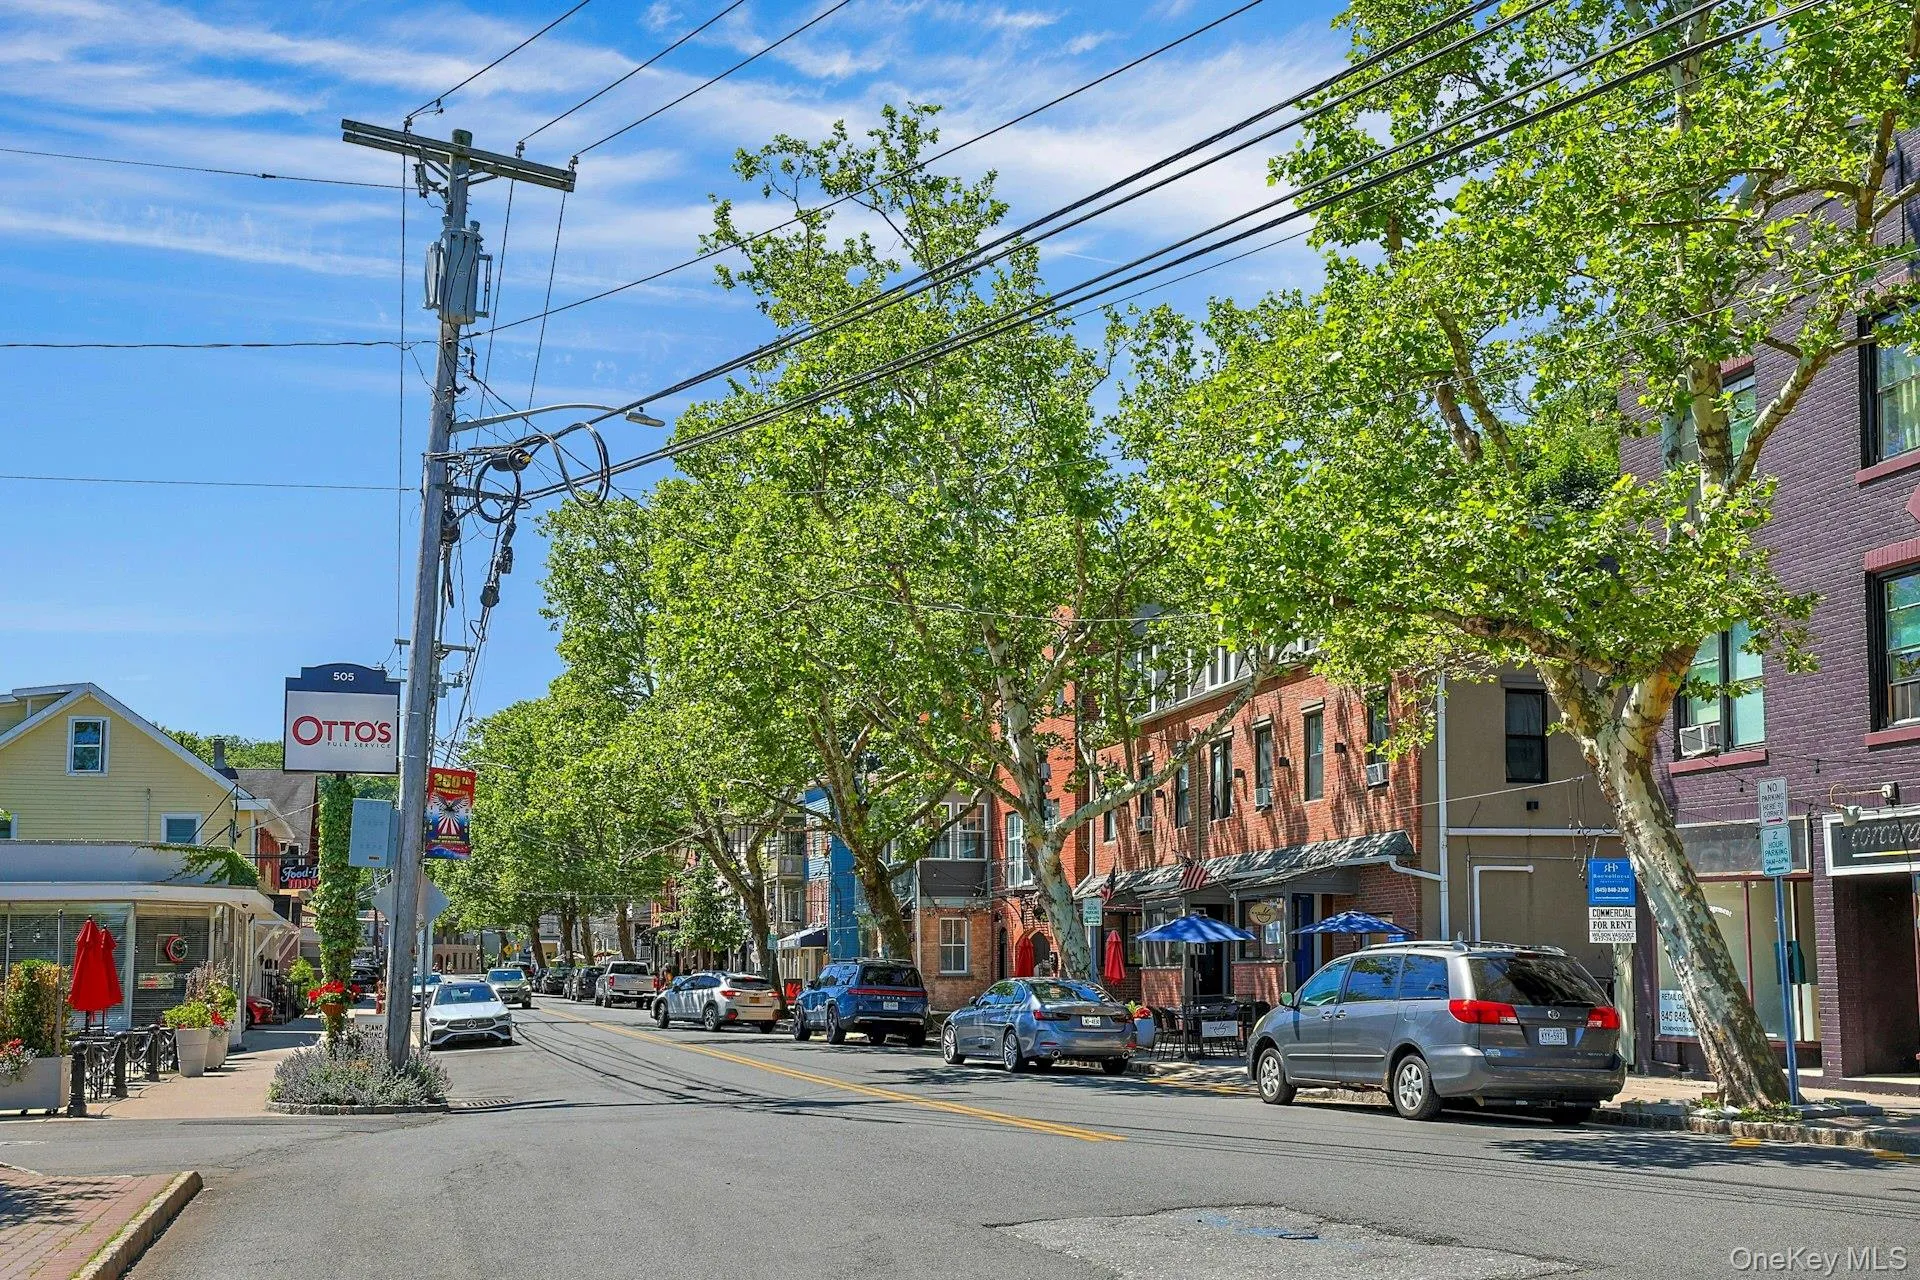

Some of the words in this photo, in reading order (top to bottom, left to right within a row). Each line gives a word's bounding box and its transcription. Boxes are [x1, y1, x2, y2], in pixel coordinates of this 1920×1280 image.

[333, 672, 355, 681] 505
[292, 715, 392, 746] OTTO'S
[1767, 783, 1778, 792] NO
[1762, 795, 1784, 803] PARKING
[1763, 803, 1776, 811] HERE
[1764, 810, 1784, 818] CORNER
[1772, 831, 1778, 840] 2
[1765, 848, 1788, 856] PARKING
[1592, 908, 1632, 918] COMMERCIAL
[1592, 921, 1608, 930] FOR
[1610, 921, 1632, 930] RENT
[1661, 1010, 1672, 1021] 845
